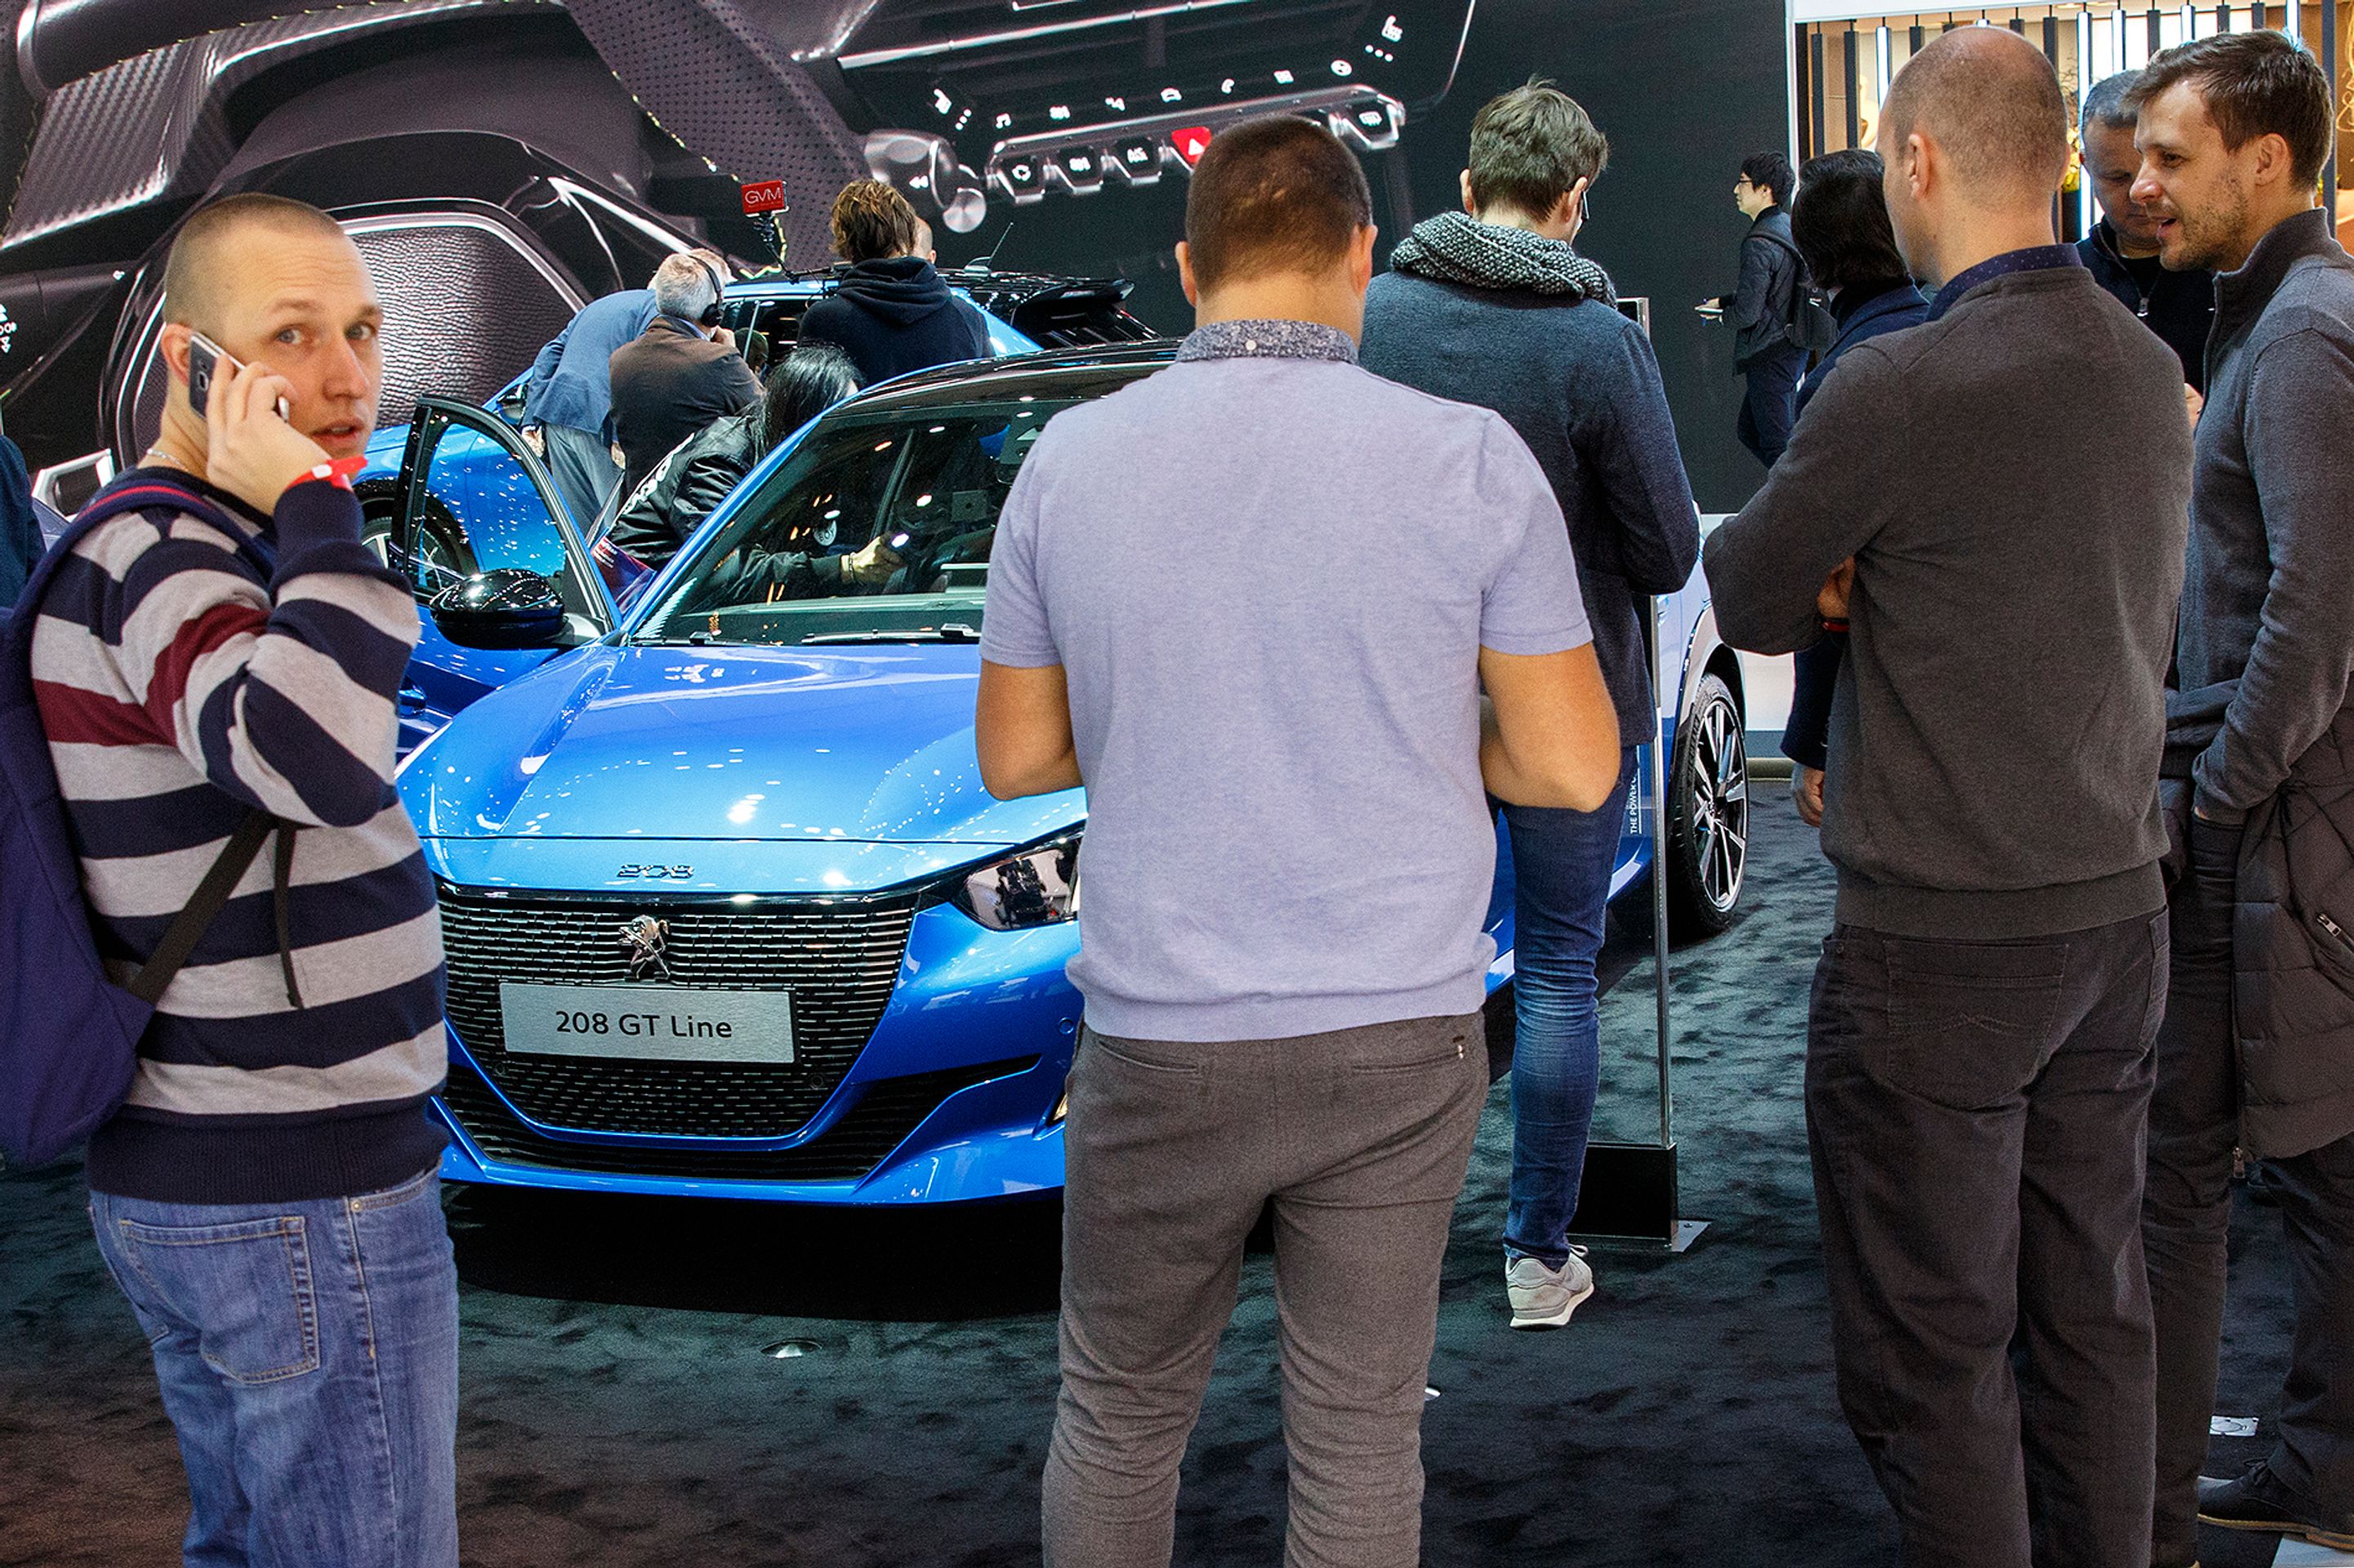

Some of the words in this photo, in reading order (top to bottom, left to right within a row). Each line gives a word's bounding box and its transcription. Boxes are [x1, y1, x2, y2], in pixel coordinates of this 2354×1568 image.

[744, 187, 782, 204] GVM
[1630, 816, 1638, 835] THE
[617, 863, 694, 879] 208
[555, 1010, 609, 1035] 208
[618, 1013, 660, 1036] GT
[671, 1015, 733, 1038] Line
